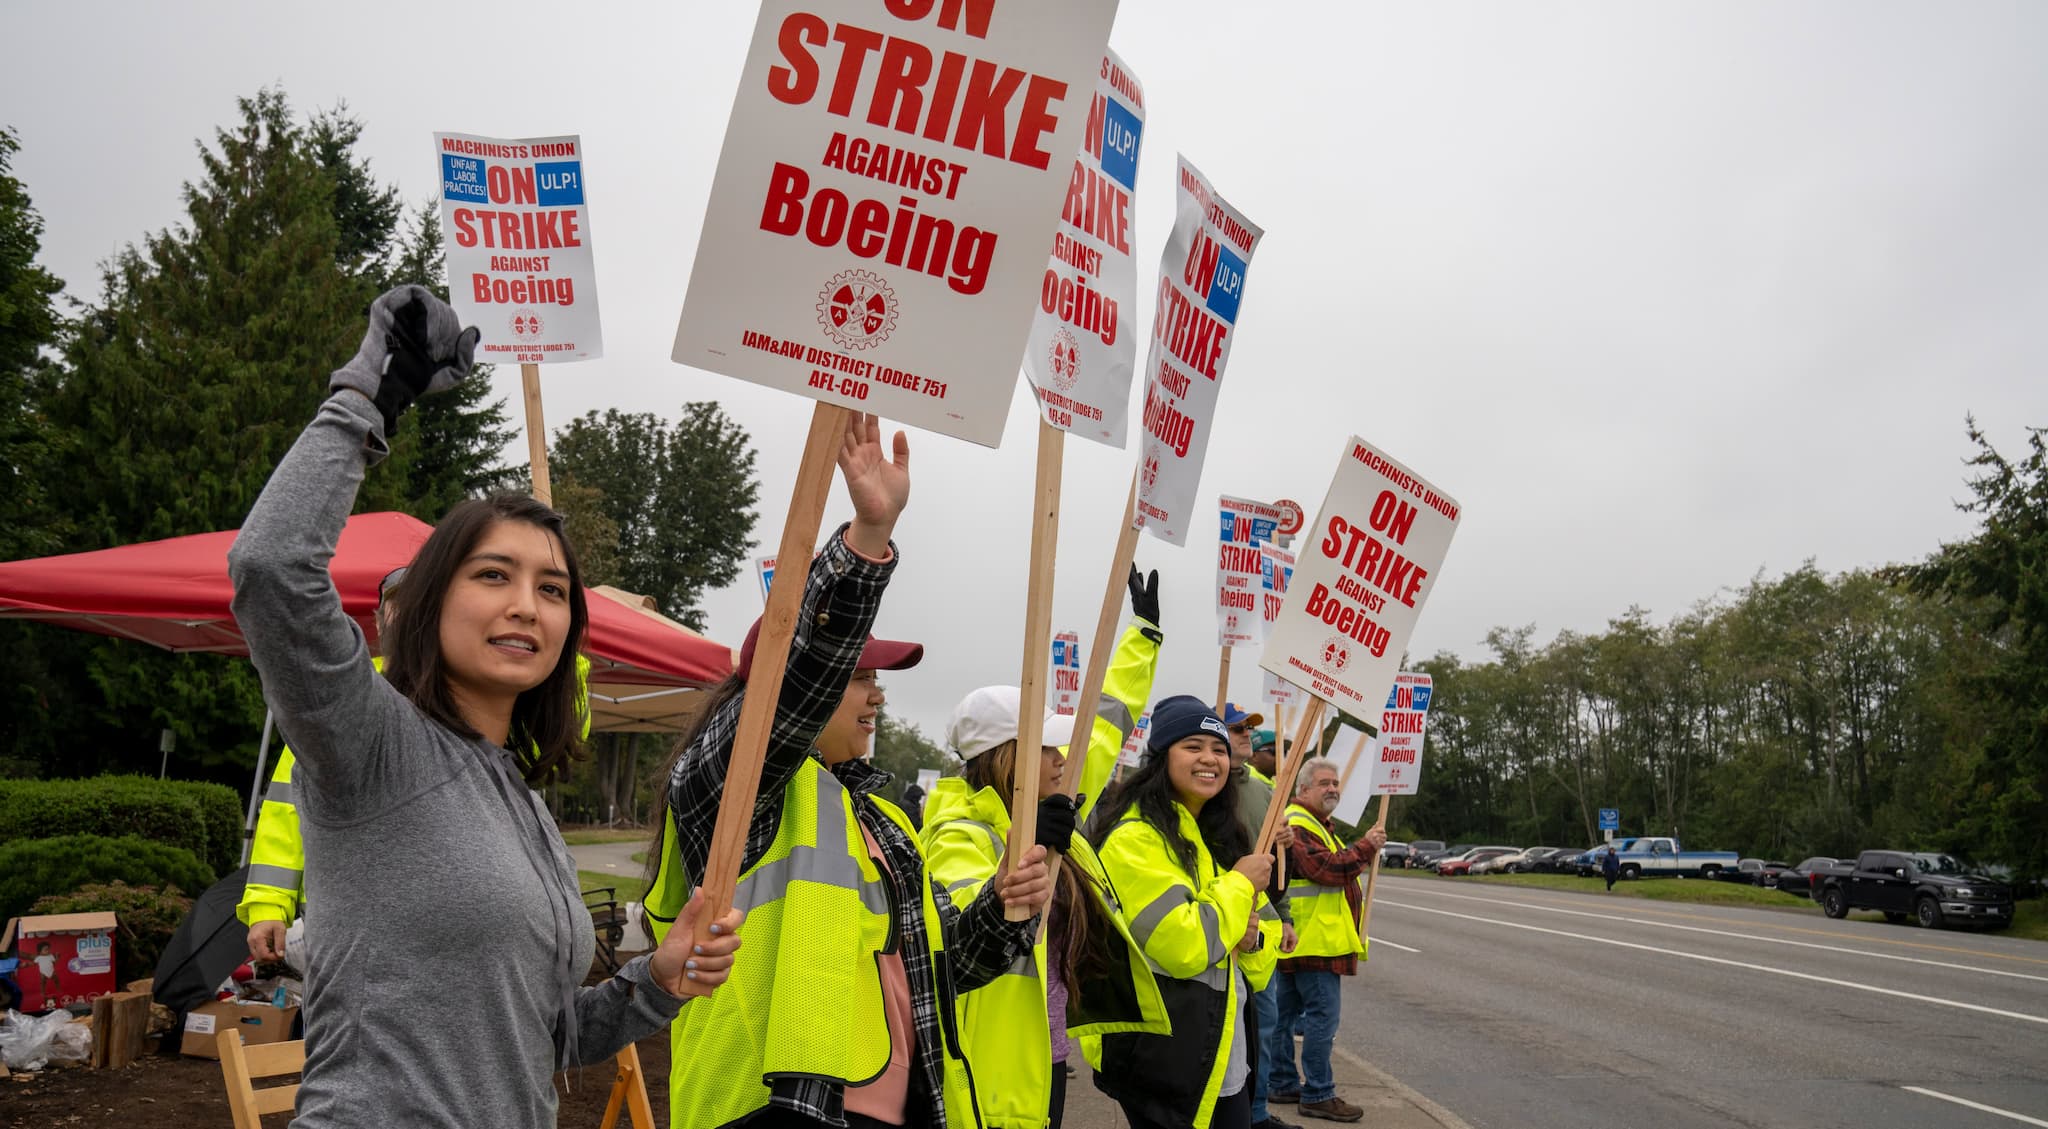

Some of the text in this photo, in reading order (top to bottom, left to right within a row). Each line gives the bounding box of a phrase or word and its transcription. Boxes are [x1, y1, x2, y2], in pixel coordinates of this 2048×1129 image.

[767, 12, 1068, 171] STRIKE
[1110, 63, 1142, 109] UNION
[1085, 90, 1106, 160] N
[1108, 117, 1136, 162] ULP!
[442, 138, 575, 158] MACHINISTS UNION
[451, 158, 477, 171] UNFAIR
[453, 171, 477, 183] LABOR
[541, 172, 577, 190] ULP!
[822, 132, 968, 200] AGAINST
[445, 181, 487, 196] PRACTICES!
[488, 165, 537, 204] ON
[1061, 159, 1129, 256] RIKE
[454, 208, 581, 249] STRIKE
[760, 162, 998, 295] Boeing
[1224, 215, 1255, 253] UNION
[491, 256, 550, 272] AGAINST
[1184, 226, 1220, 299] ON
[472, 273, 574, 306] Boeing
[1217, 262, 1241, 299] ULP!
[1041, 268, 1118, 346] oeing
[1155, 276, 1227, 381] STRIKE
[543, 344, 563, 352] LODGE
[564, 343, 575, 351] 751
[742, 330, 947, 398] IAM&AW DISTRICT LODGE 751
[808, 370, 869, 400] AFL-CIO
[1047, 390, 1072, 411] DISTRICT
[1073, 400, 1091, 418] LODGE
[1092, 407, 1103, 422] 751
[1049, 407, 1071, 427] AFL-CIO
[1143, 380, 1194, 458] Boeing
[1352, 443, 1458, 521] MACHINISTS UNION
[1160, 510, 1169, 522] 751
[1255, 506, 1281, 519] UNION
[1369, 490, 1418, 546] ON
[1233, 516, 1252, 543] ON
[1220, 544, 1262, 575] STRIKE
[1322, 515, 1428, 609] STRIKE
[1273, 563, 1285, 594] ON
[1335, 574, 1386, 614] AGAINST
[1220, 587, 1255, 611] Boeing
[1305, 582, 1391, 658] Boeing
[1312, 669, 1338, 687] DISTRICT
[1337, 683, 1354, 698] LODGE
[1354, 691, 1363, 702] 751
[1312, 680, 1335, 697] AFL-CIO
[1397, 687, 1412, 708] ON
[1382, 712, 1423, 733] STRIKE
[1381, 746, 1416, 764] Boeing
[79, 933, 110, 952] plus
